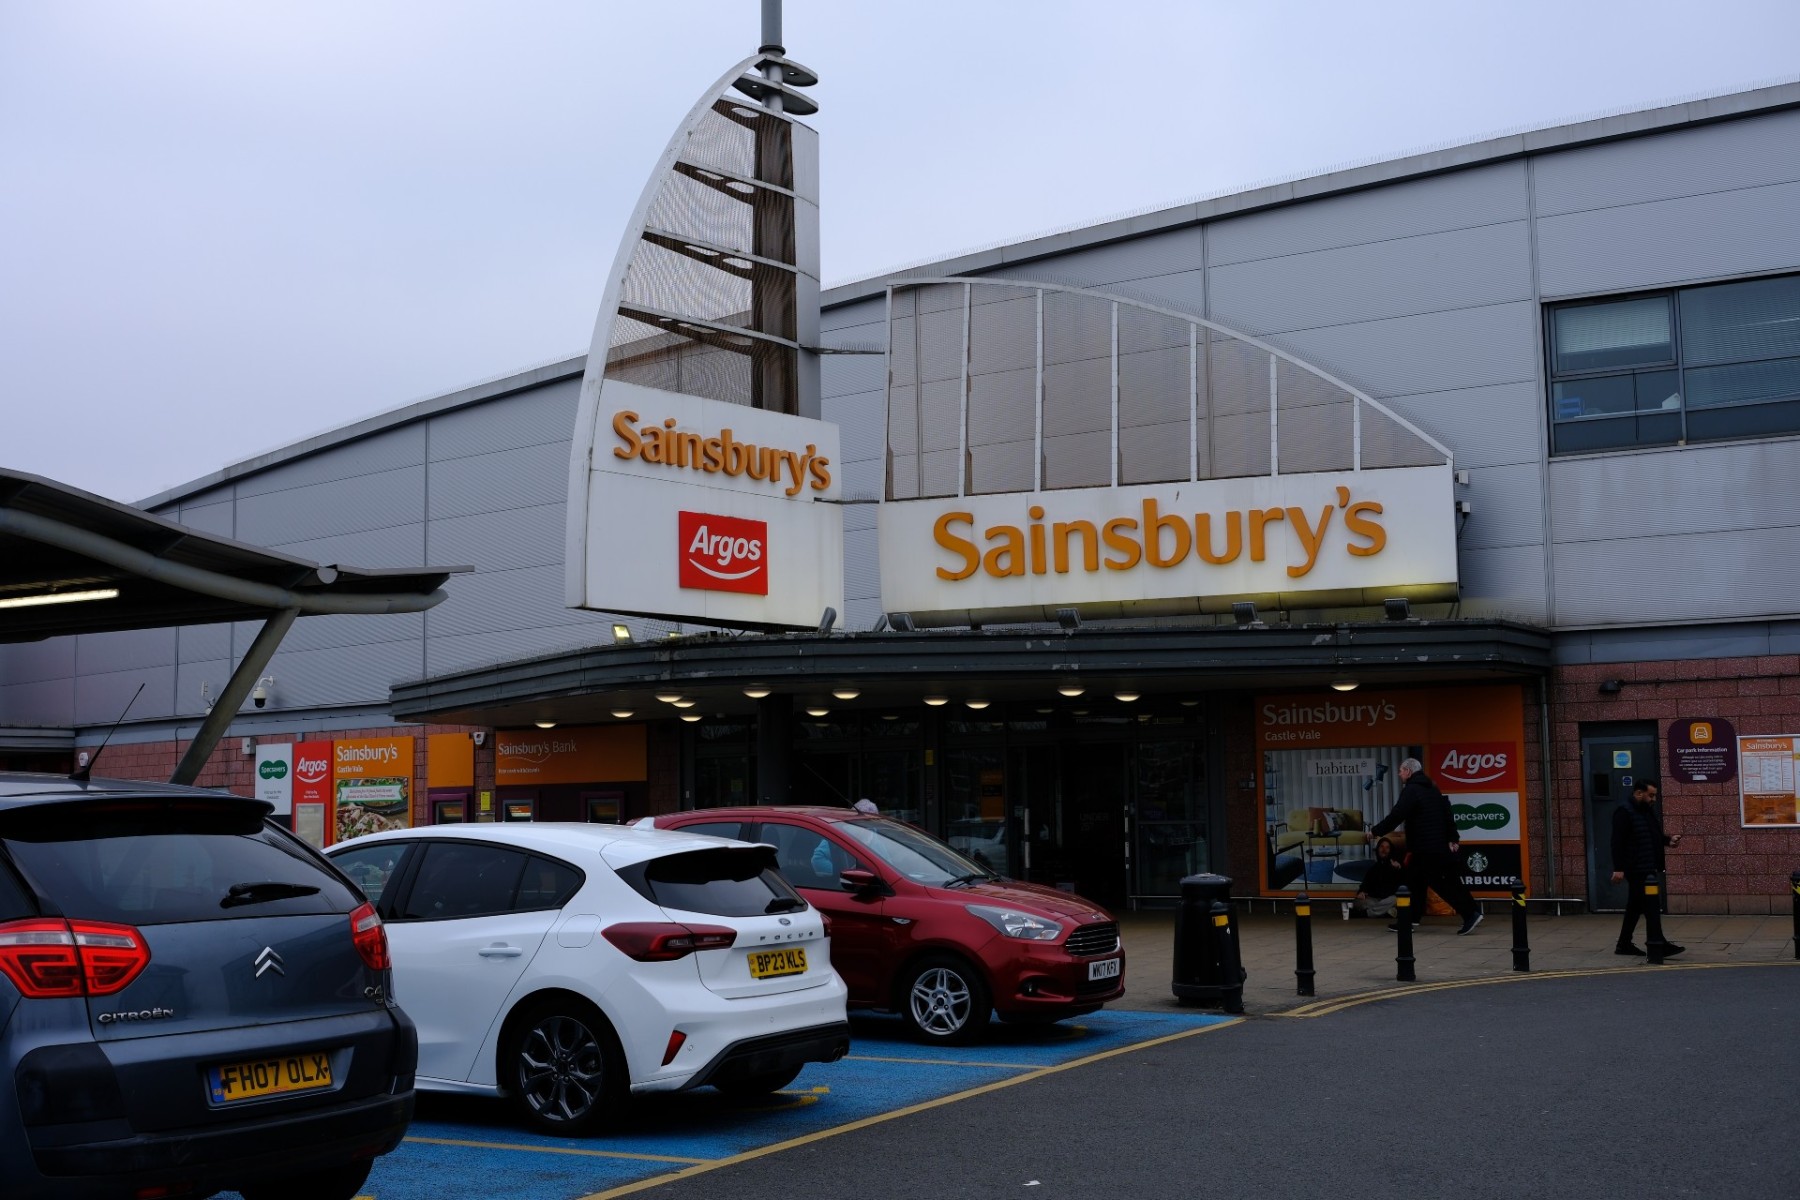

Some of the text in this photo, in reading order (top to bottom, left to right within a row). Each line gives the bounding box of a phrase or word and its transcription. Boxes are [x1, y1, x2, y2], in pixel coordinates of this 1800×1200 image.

[612, 410, 831, 496] Sainsbury's
[933, 486, 1387, 581] Sainsbury's
[689, 525, 762, 566] Argos
[1262, 700, 1396, 726] Sainsbury's
[1265, 730, 1321, 741] Castle Vale
[336, 743, 398, 763] Sainsbury's
[498, 739, 577, 757] Sainsbury's Bank
[1746, 742, 1787, 751] Sainsbury's
[260, 766, 286, 774] Specsavers
[297, 756, 327, 776] Argos
[1315, 761, 1360, 775] habitat
[1441, 750, 1507, 775] Argos
[1453, 812, 1505, 822] pecsavers
[1459, 875, 1516, 885] RBUCKS
[756, 950, 806, 973] BP23 KLS
[97, 1007, 174, 1024] CITROËN
[222, 1055, 327, 1093] FH07 OLX
